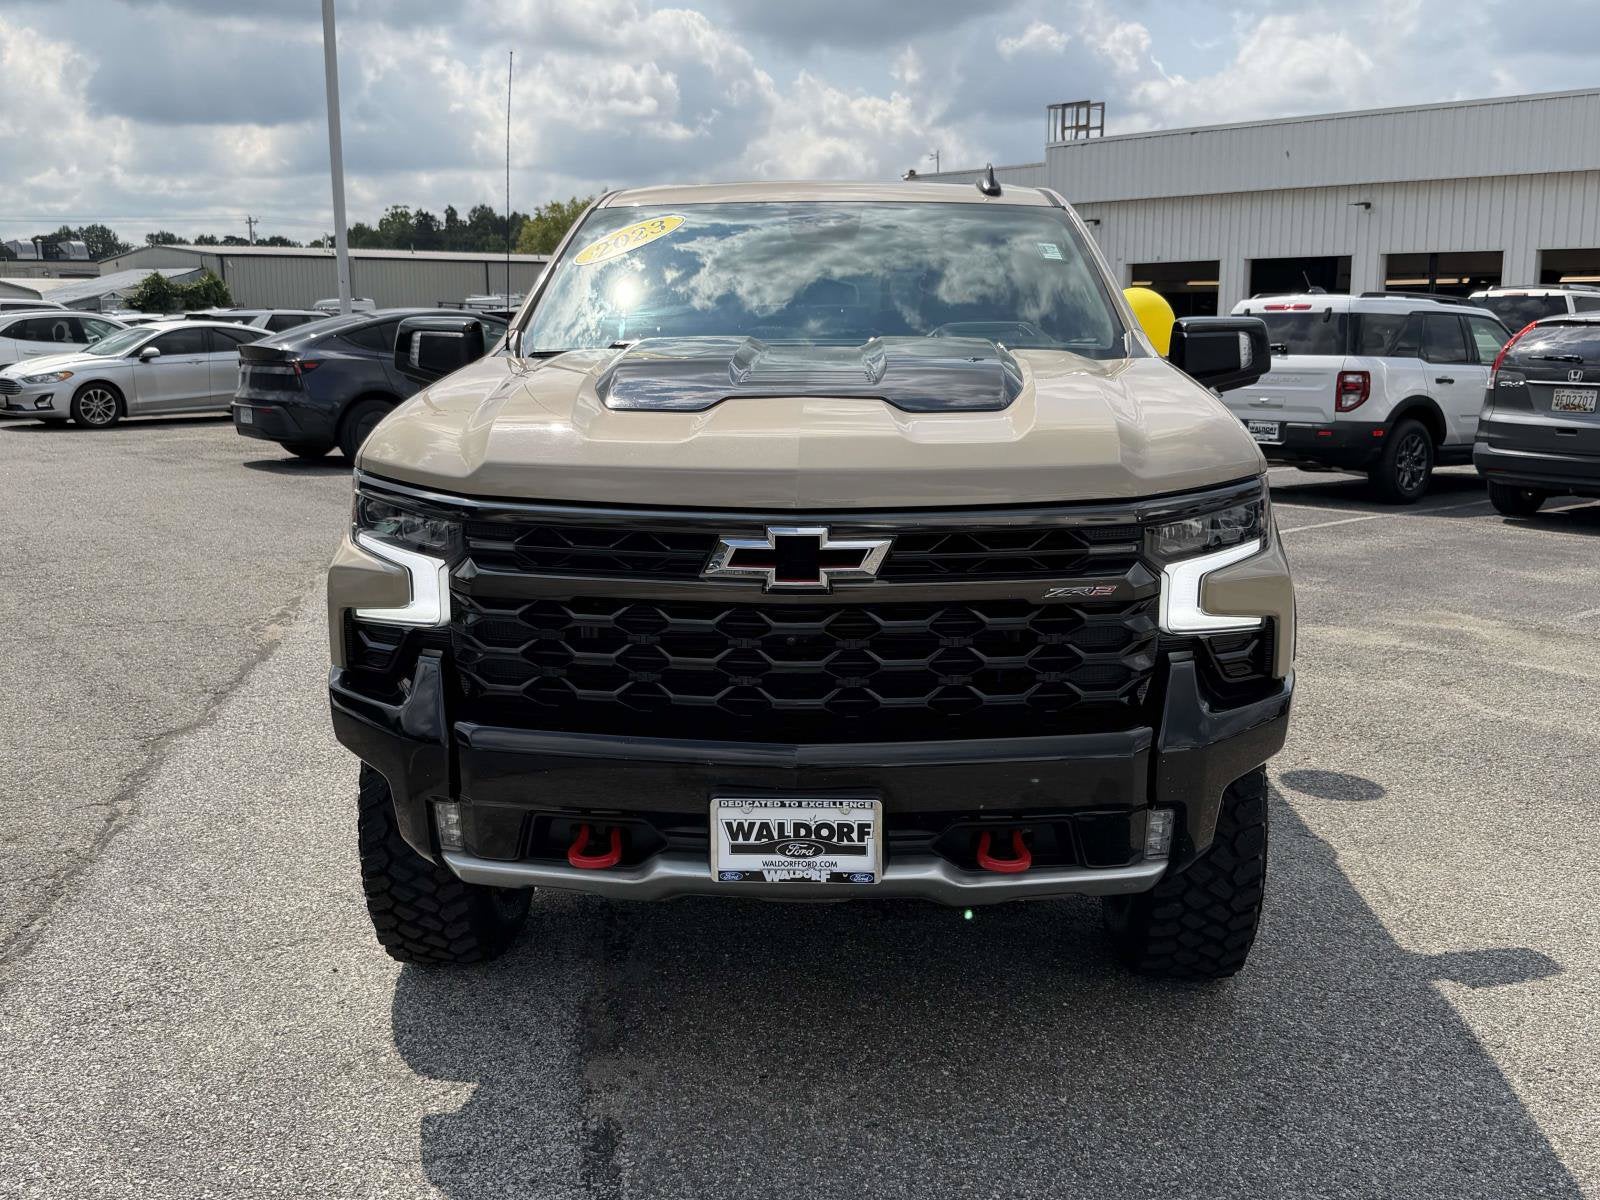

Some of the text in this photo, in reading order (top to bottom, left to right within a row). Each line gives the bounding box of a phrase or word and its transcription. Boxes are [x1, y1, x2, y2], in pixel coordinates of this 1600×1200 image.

[592, 220, 666, 257] 2023
[720, 800, 783, 808] DEDICATED
[801, 801, 873, 809] EXCELLENCE
[722, 820, 873, 844] WALDORF
[785, 843, 814, 856] Ford
[762, 860, 838, 868] WALDORFFORD.COM
[762, 870, 831, 883] WALDORF
